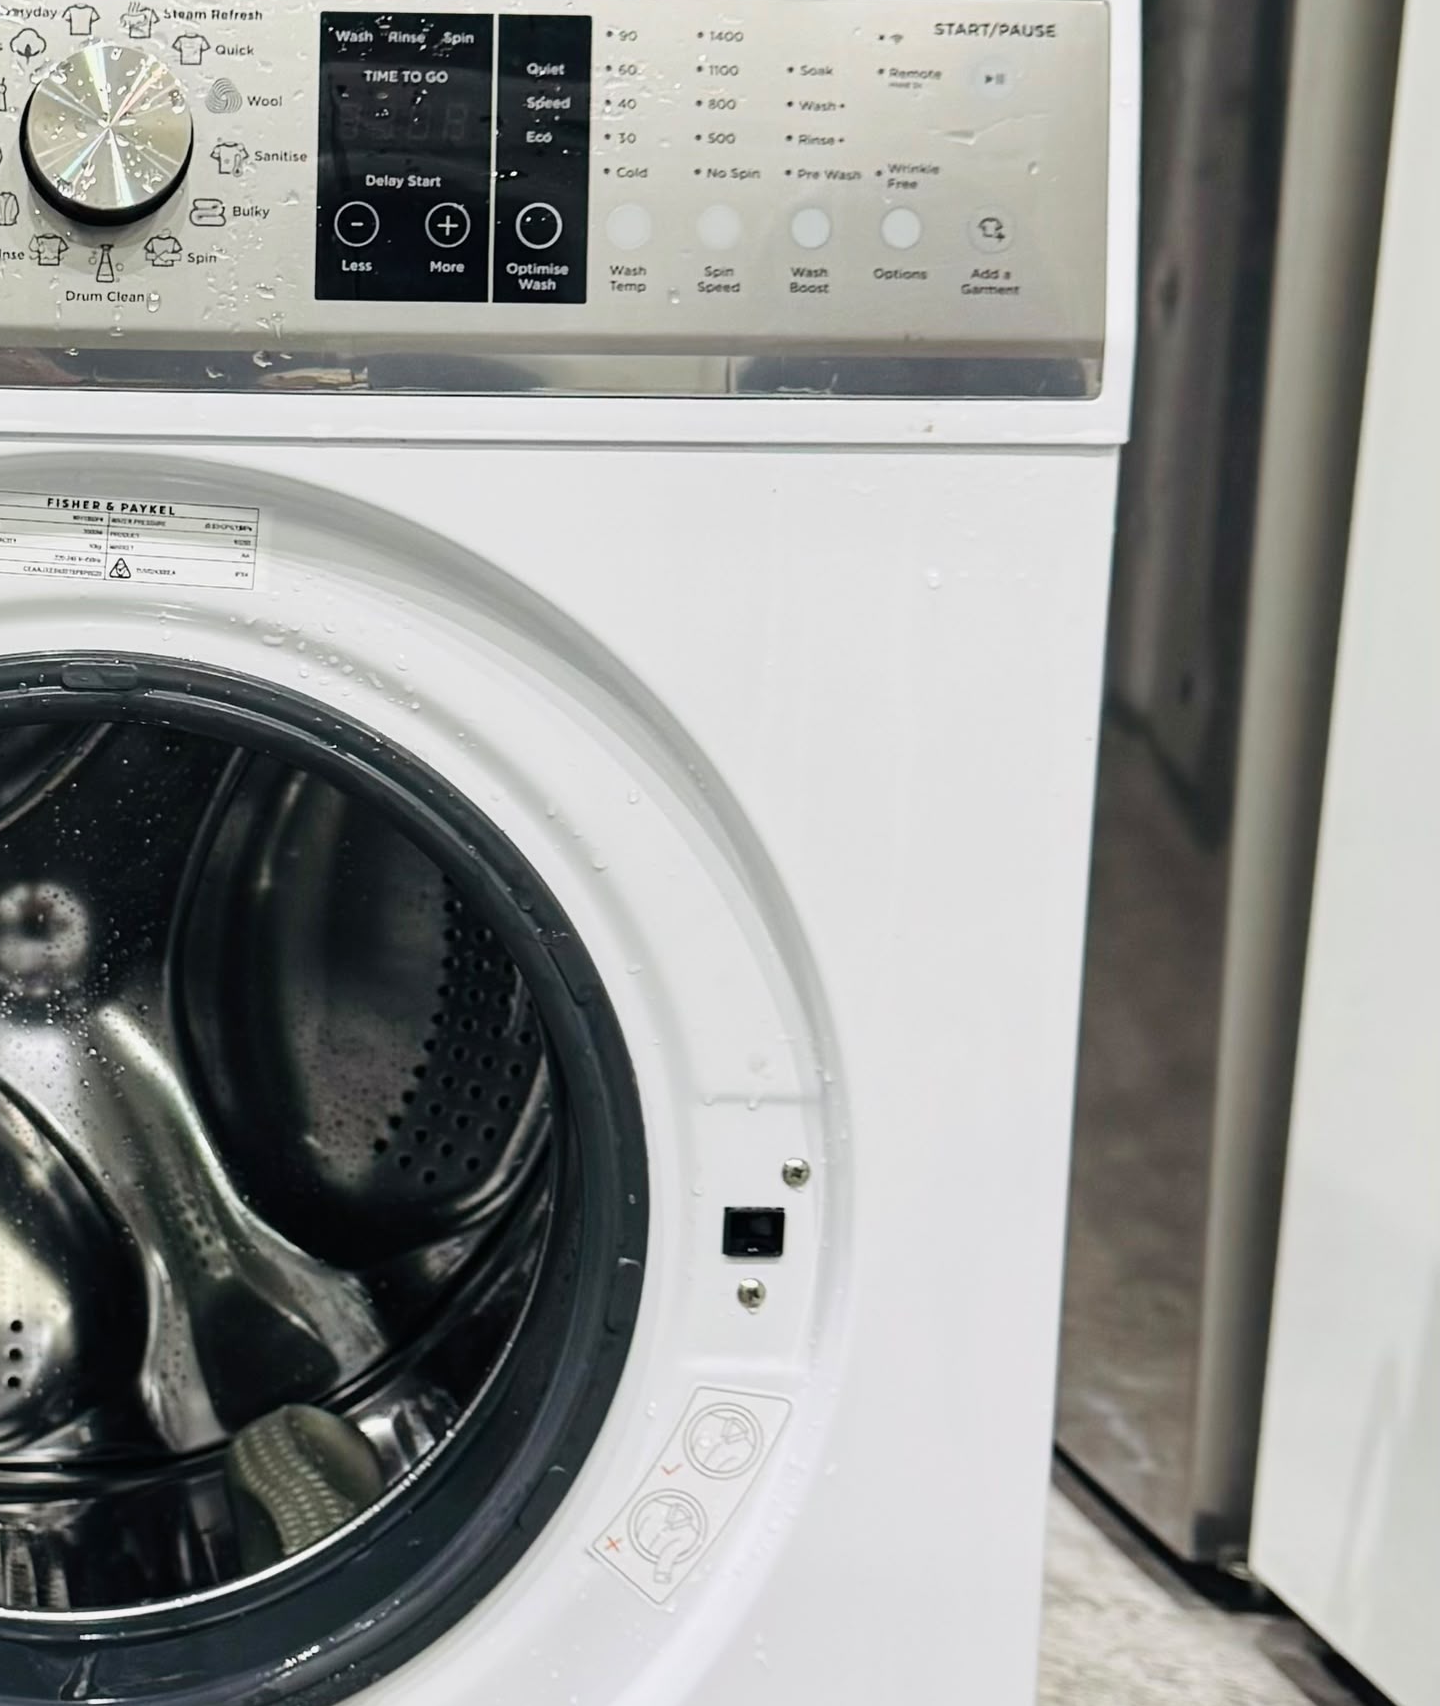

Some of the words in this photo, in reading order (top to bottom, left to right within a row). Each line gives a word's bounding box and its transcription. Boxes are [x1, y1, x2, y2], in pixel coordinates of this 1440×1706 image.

[164, 8, 206, 21] Steam
[618, 30, 638, 42] 90
[709, 30, 744, 43] 1400
[933, 21, 1057, 40] START/PAUSE
[335, 30, 374, 43] Wash
[388, 31, 427, 44] Rinse
[443, 31, 475, 46] Spin
[215, 43, 256, 58] Quick
[527, 62, 566, 77] Quiet
[618, 64, 637, 76] 60
[708, 64, 740, 76] 1100
[799, 64, 834, 77] Soak
[889, 67, 943, 80] Remote
[364, 70, 398, 83] TIME
[402, 71, 422, 83] TO
[426, 71, 449, 83] GO
[247, 94, 283, 107] Wool
[526, 96, 571, 112] Speed
[617, 98, 637, 110] 40
[708, 98, 737, 110] 800
[526, 131, 553, 144] Eco
[617, 132, 637, 144] 30
[707, 132, 736, 144] 500
[254, 150, 308, 164] Sanitise
[616, 167, 649, 179] Cold
[706, 167, 725, 179] No
[728, 167, 761, 182] Spin
[797, 168, 824, 181] Pre
[827, 168, 862, 182] Wash
[887, 162, 941, 176] Wrinkle
[365, 175, 404, 190] Delay
[408, 176, 441, 188] Start
[887, 178, 919, 190] Free
[232, 204, 270, 220] Bulky
[187, 251, 218, 266] Spin
[341, 260, 373, 273] Less
[430, 261, 465, 273] More
[506, 262, 569, 278] Optimise
[609, 265, 647, 278] Wash
[704, 265, 735, 280] Spin
[790, 266, 828, 279] Wash
[873, 268, 928, 283] Options
[970, 268, 999, 280] Add
[518, 278, 557, 291] Wash
[609, 281, 647, 296] Temp
[697, 281, 740, 296] Speed
[789, 282, 829, 295] Boost
[961, 283, 1021, 297] Garment
[65, 291, 102, 303] Drum
[107, 290, 145, 303] Clean
[47, 497, 101, 510] FISHER
[106, 501, 115, 511] &
[121, 502, 176, 515] PAYKEL
